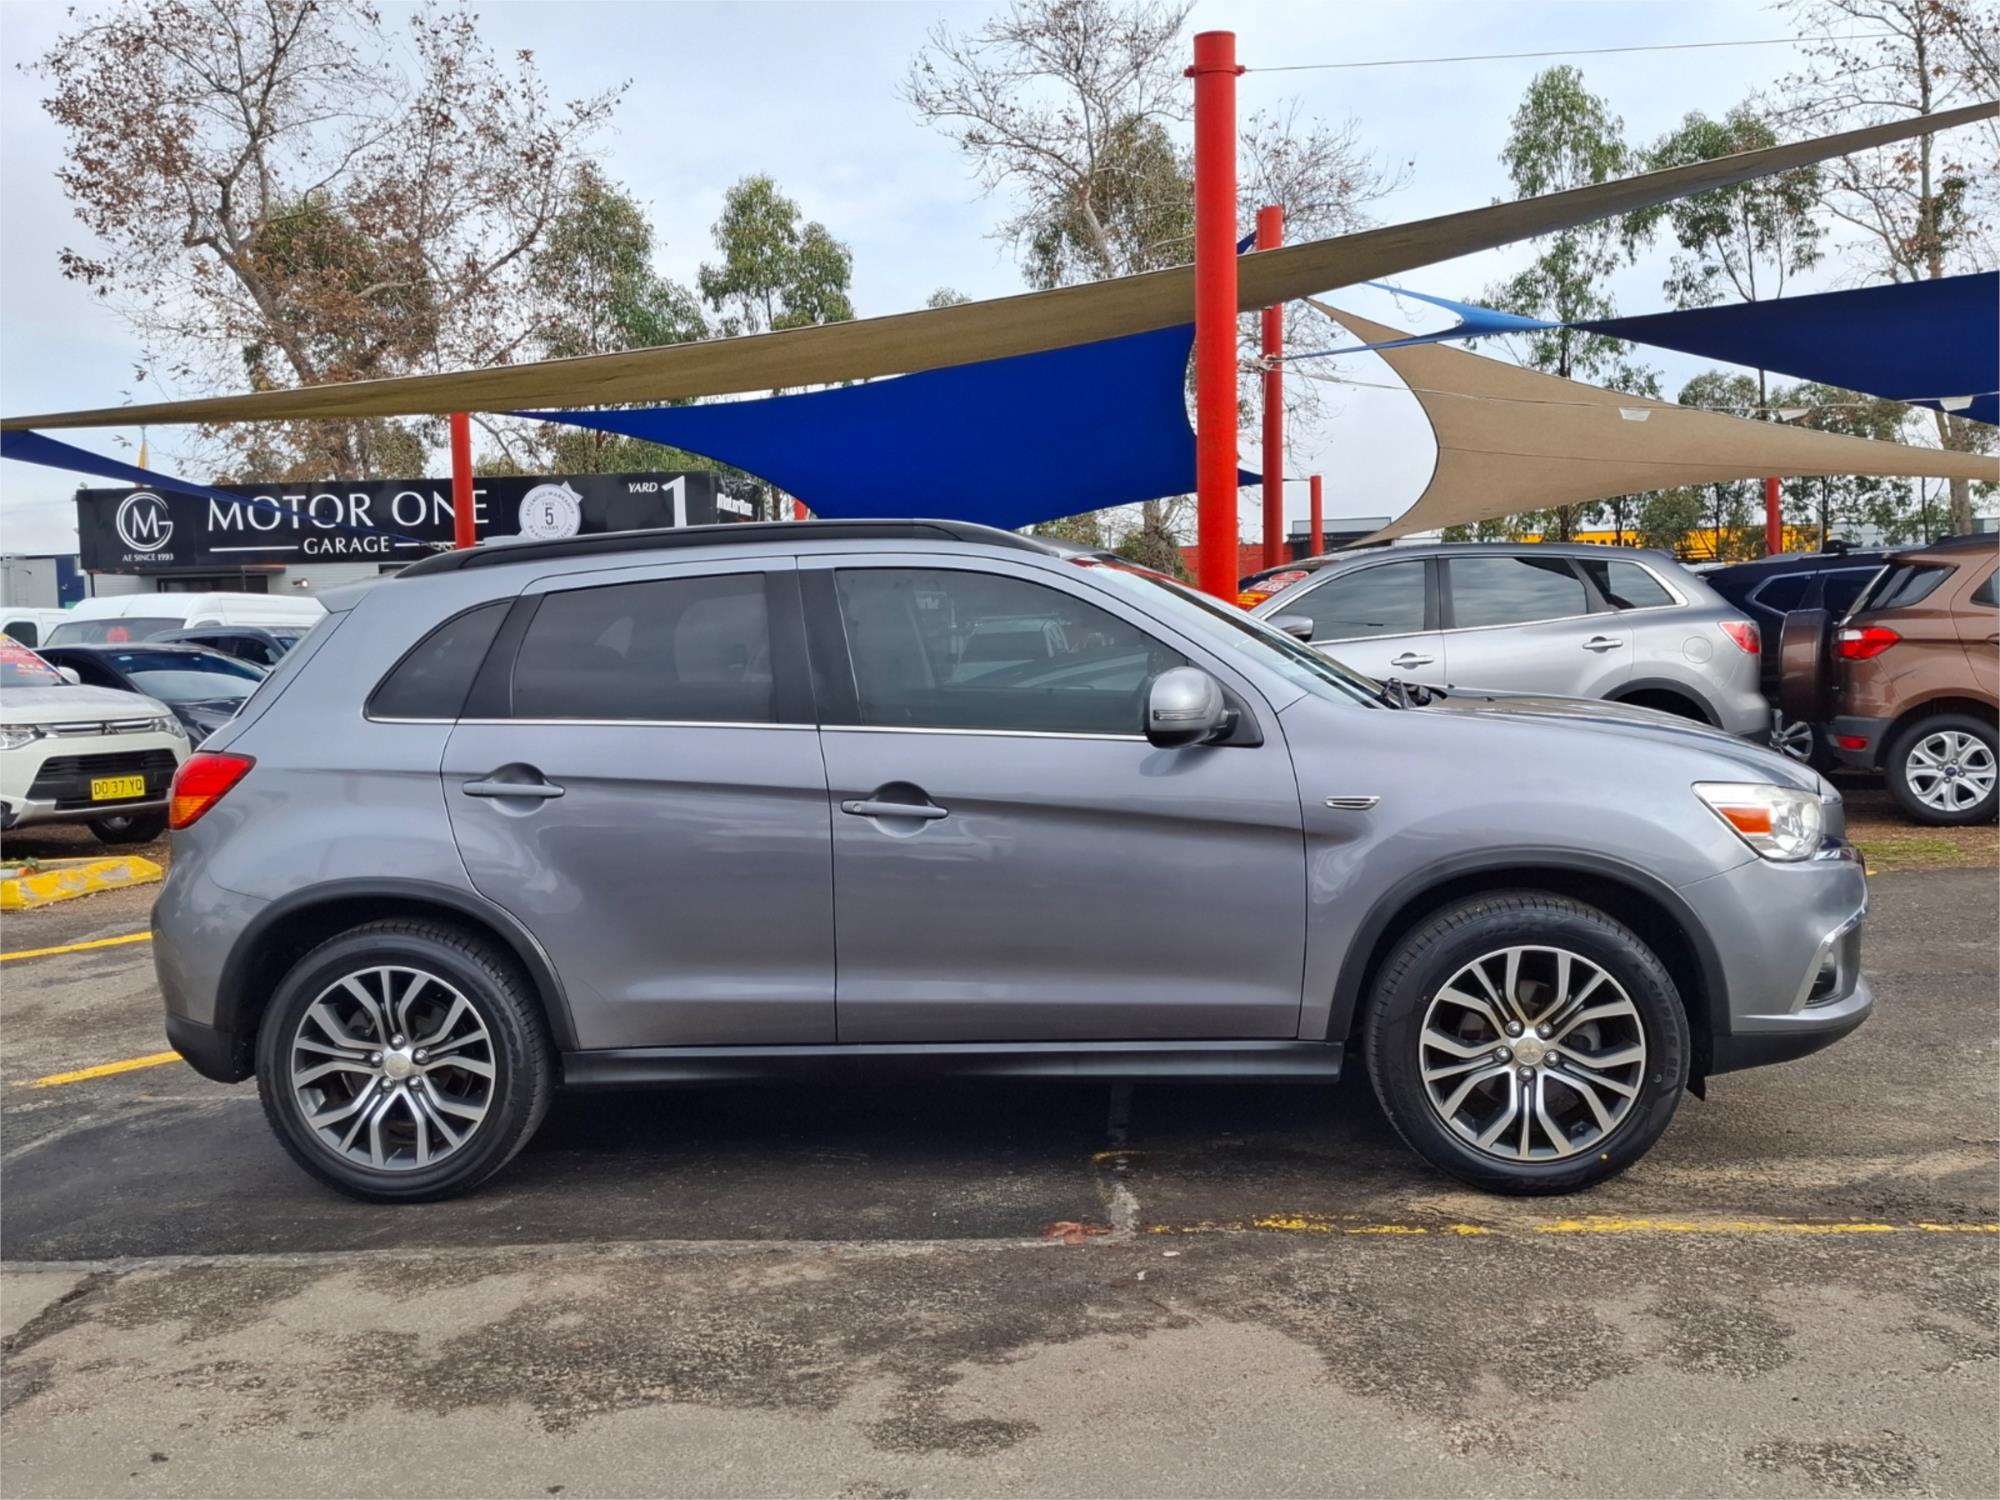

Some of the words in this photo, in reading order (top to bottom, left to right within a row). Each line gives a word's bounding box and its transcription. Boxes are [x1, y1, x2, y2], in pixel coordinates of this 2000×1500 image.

[208, 493, 375, 532] MOTOR
[391, 490, 489, 527] ONE
[628, 482, 658, 493] YARD
[661, 475, 687, 528] 1
[545, 507, 554, 526] 5
[303, 536, 390, 555] GARAGE
[134, 552, 156, 562] SINCE
[157, 552, 174, 561] 1993
[112, 780, 125, 793] 37
